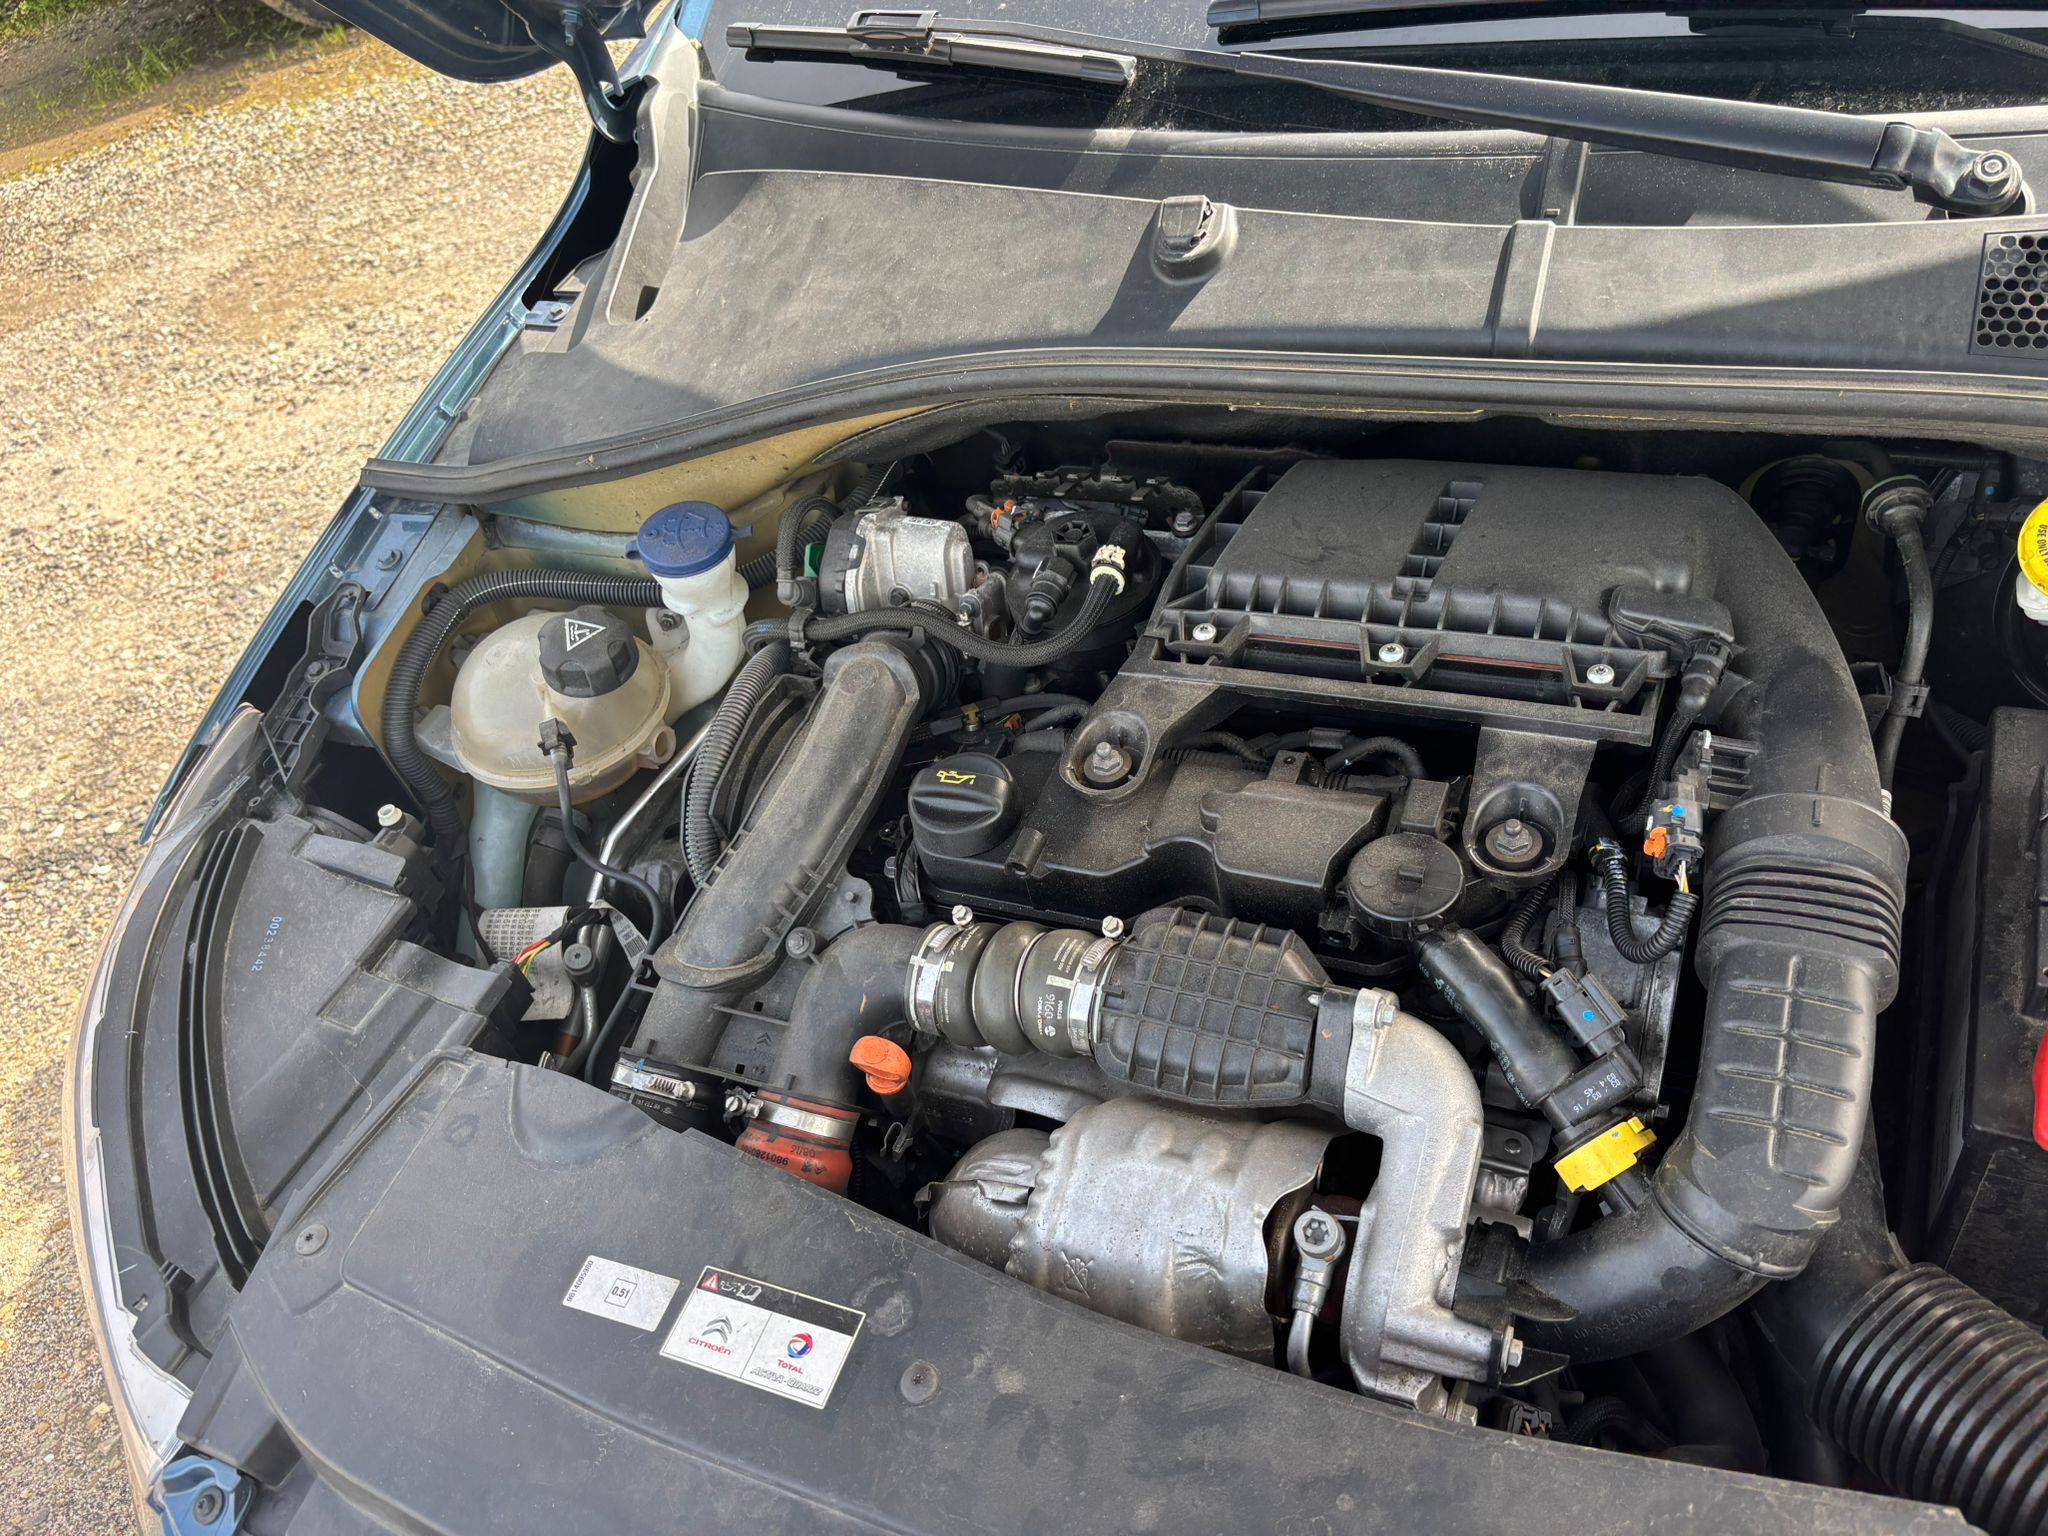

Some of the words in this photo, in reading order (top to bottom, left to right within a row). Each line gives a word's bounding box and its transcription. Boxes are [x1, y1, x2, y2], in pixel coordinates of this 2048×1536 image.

[2037, 524, 2048, 537] USE
[611, 1286, 630, 1299] 0.51
[777, 1359, 804, 1375] TOTAL
